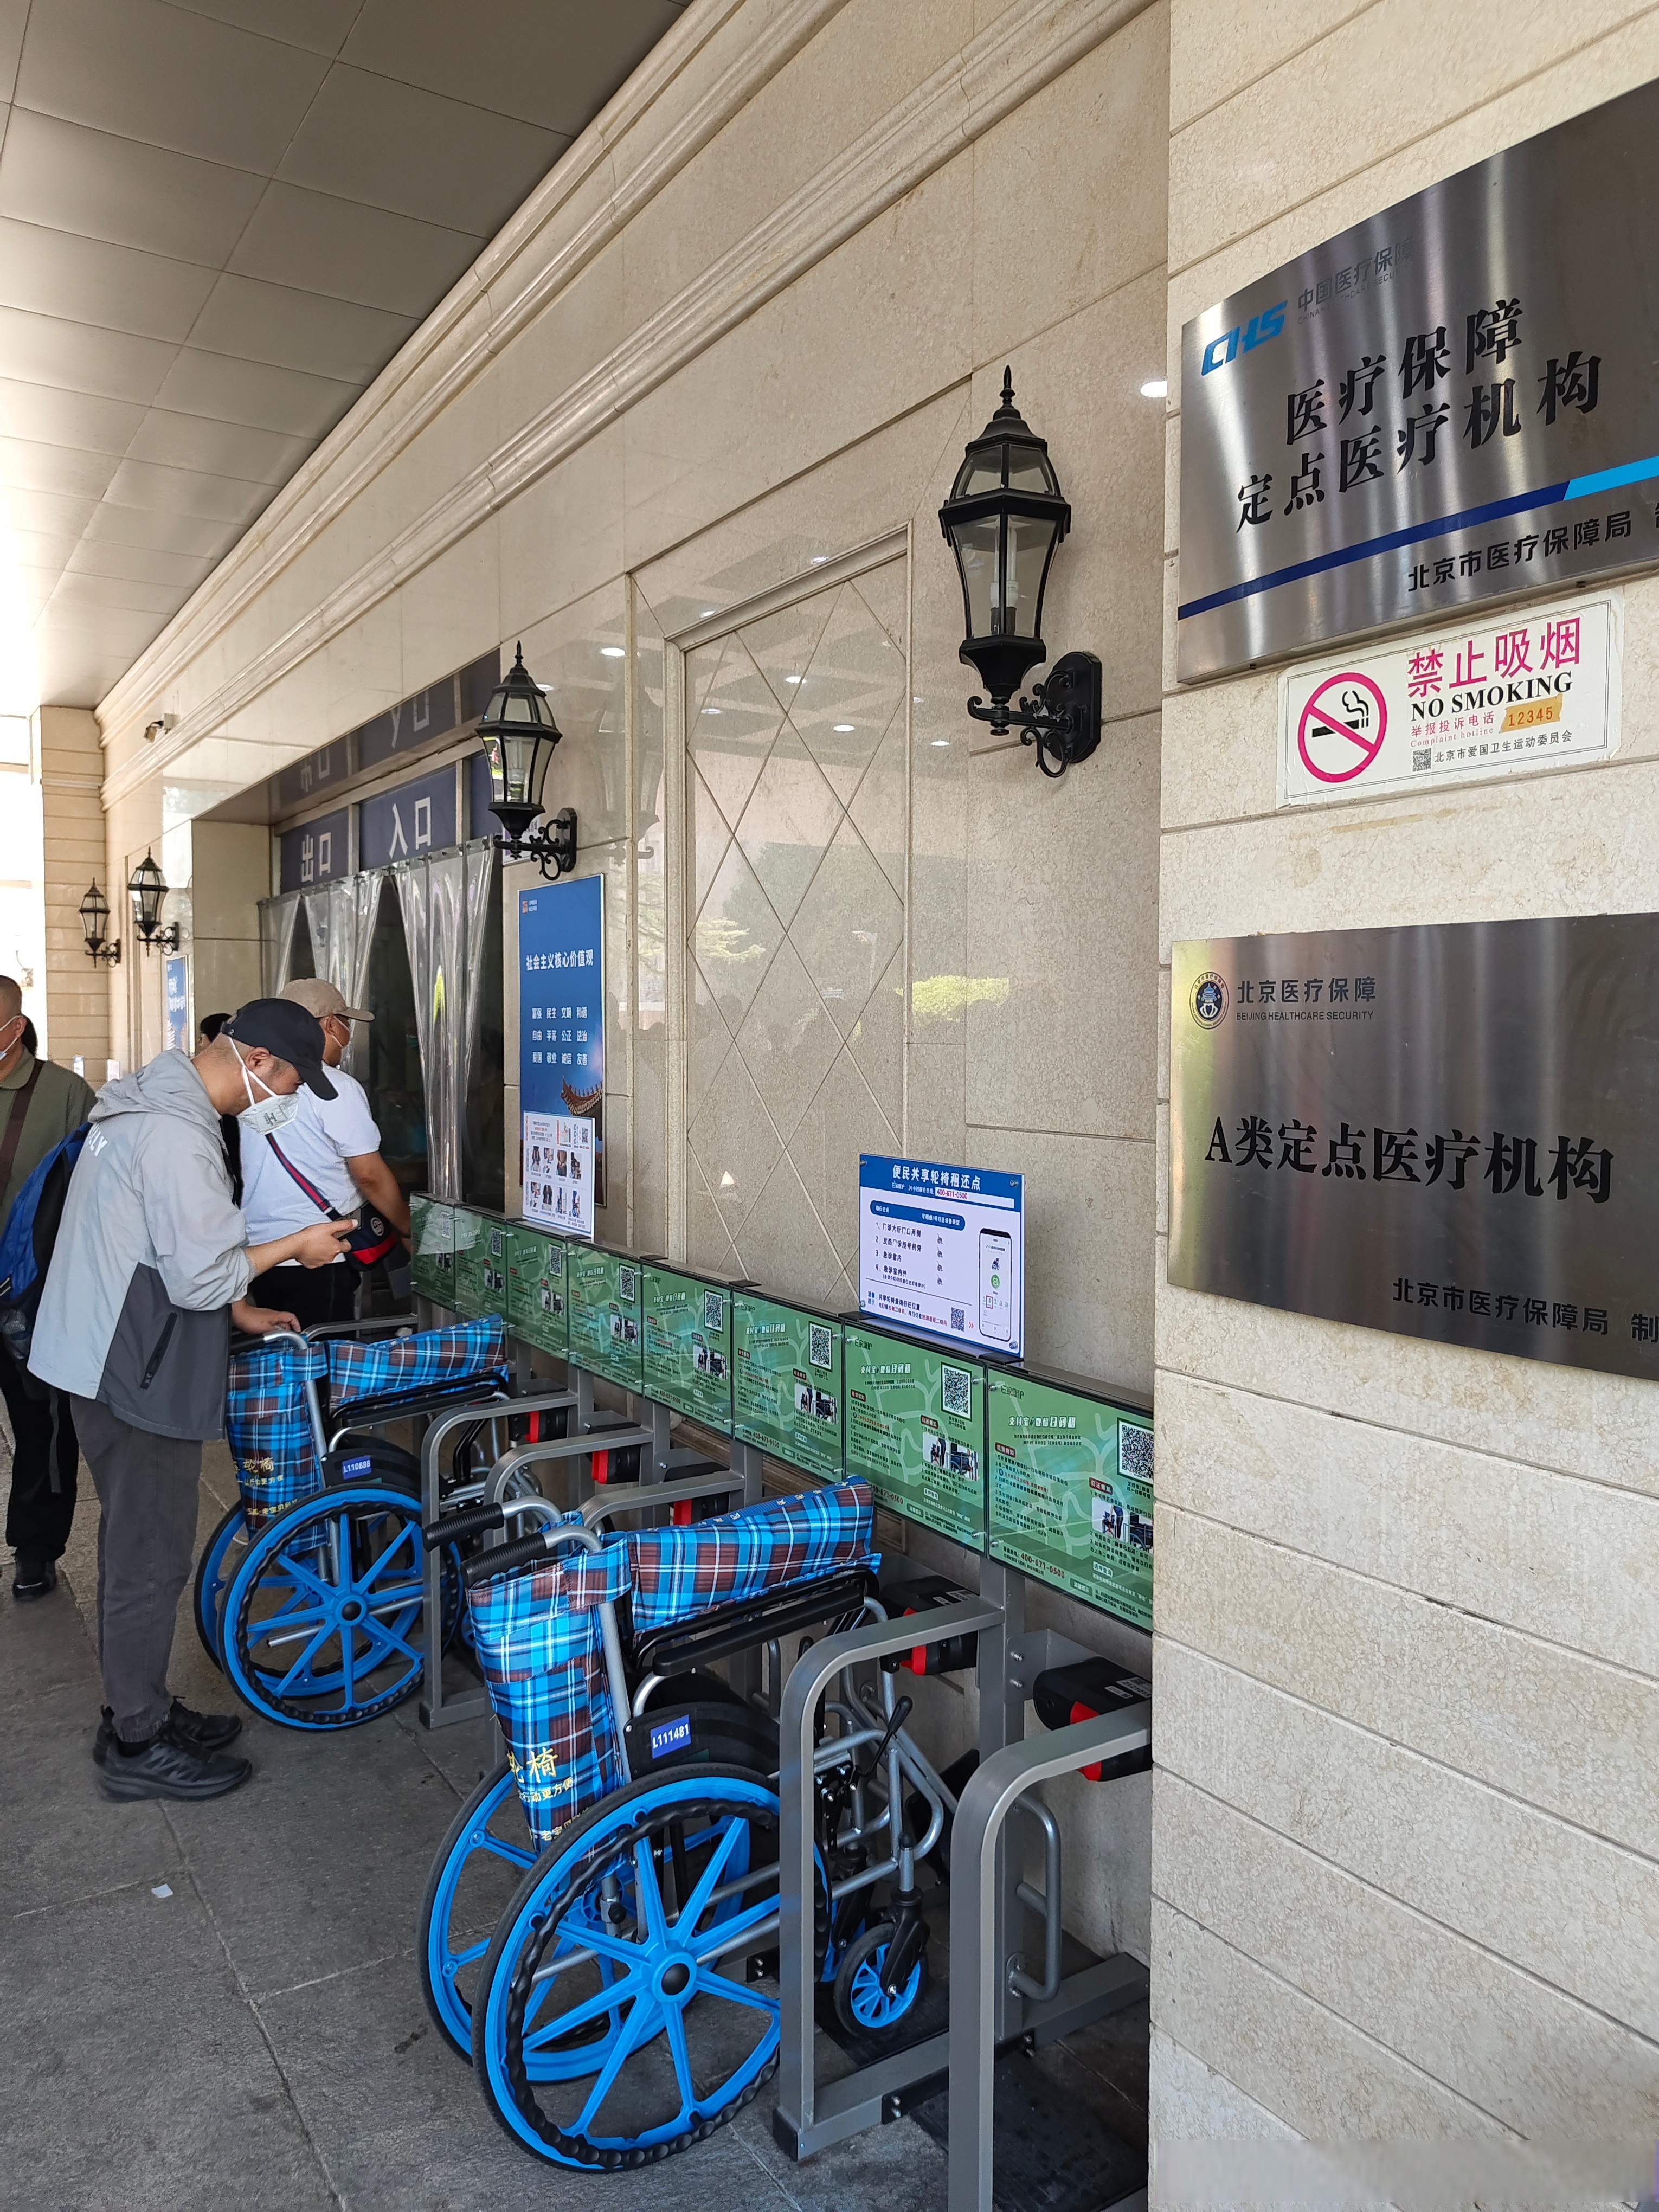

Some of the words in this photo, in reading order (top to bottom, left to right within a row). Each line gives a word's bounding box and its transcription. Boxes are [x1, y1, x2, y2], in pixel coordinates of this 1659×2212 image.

[1287, 297, 1523, 445] 医疗保障
[1236, 351, 1600, 532] 定点医疗机构
[1408, 511, 1631, 592] 北京市医疗保障局
[1407, 617, 1581, 698] 禁止吸烟
[1411, 700, 1444, 722] NO
[1451, 671, 1573, 714] SMOKING
[1411, 711, 1494, 738] 举报投诉电话
[1508, 707, 1554, 728] 12345
[1411, 734, 1457, 748] Complaint
[1461, 728, 1494, 739] hotline
[1435, 730, 1573, 763] 北京市爱国卫生运动委员会
[301, 832, 331, 883] 出口
[389, 796, 431, 859] 入口
[526, 949, 594, 971] 社会主义核心价值观
[1237, 976, 1376, 1004] 北京医疗保障
[546, 1007, 556, 1019] 民主
[561, 1007, 571, 1019] 文明
[1237, 1011, 1266, 1021] BEIJING
[1268, 1011, 1324, 1020] HEALTHCARE
[1326, 1010, 1374, 1020] SECURITY
[532, 1030, 542, 1041] 自由
[546, 1030, 557, 1041] 平等
[562, 1030, 572, 1041] 公正
[577, 1030, 587, 1042] 法治
[577, 1053, 588, 1065] 友善
[1205, 1115, 1614, 1203] A类定点医疗机构
[892, 1165, 981, 1191] 便民共享轮椅租还点
[937, 1189, 968, 1200] 400-671-0500
[1393, 1278, 1609, 1336] 北京市医疗保障局
[1631, 1314, 1659, 1343] 制
[1021, 1553, 1065, 1579] 400-671-0500
[653, 1723, 689, 1749] L111481
